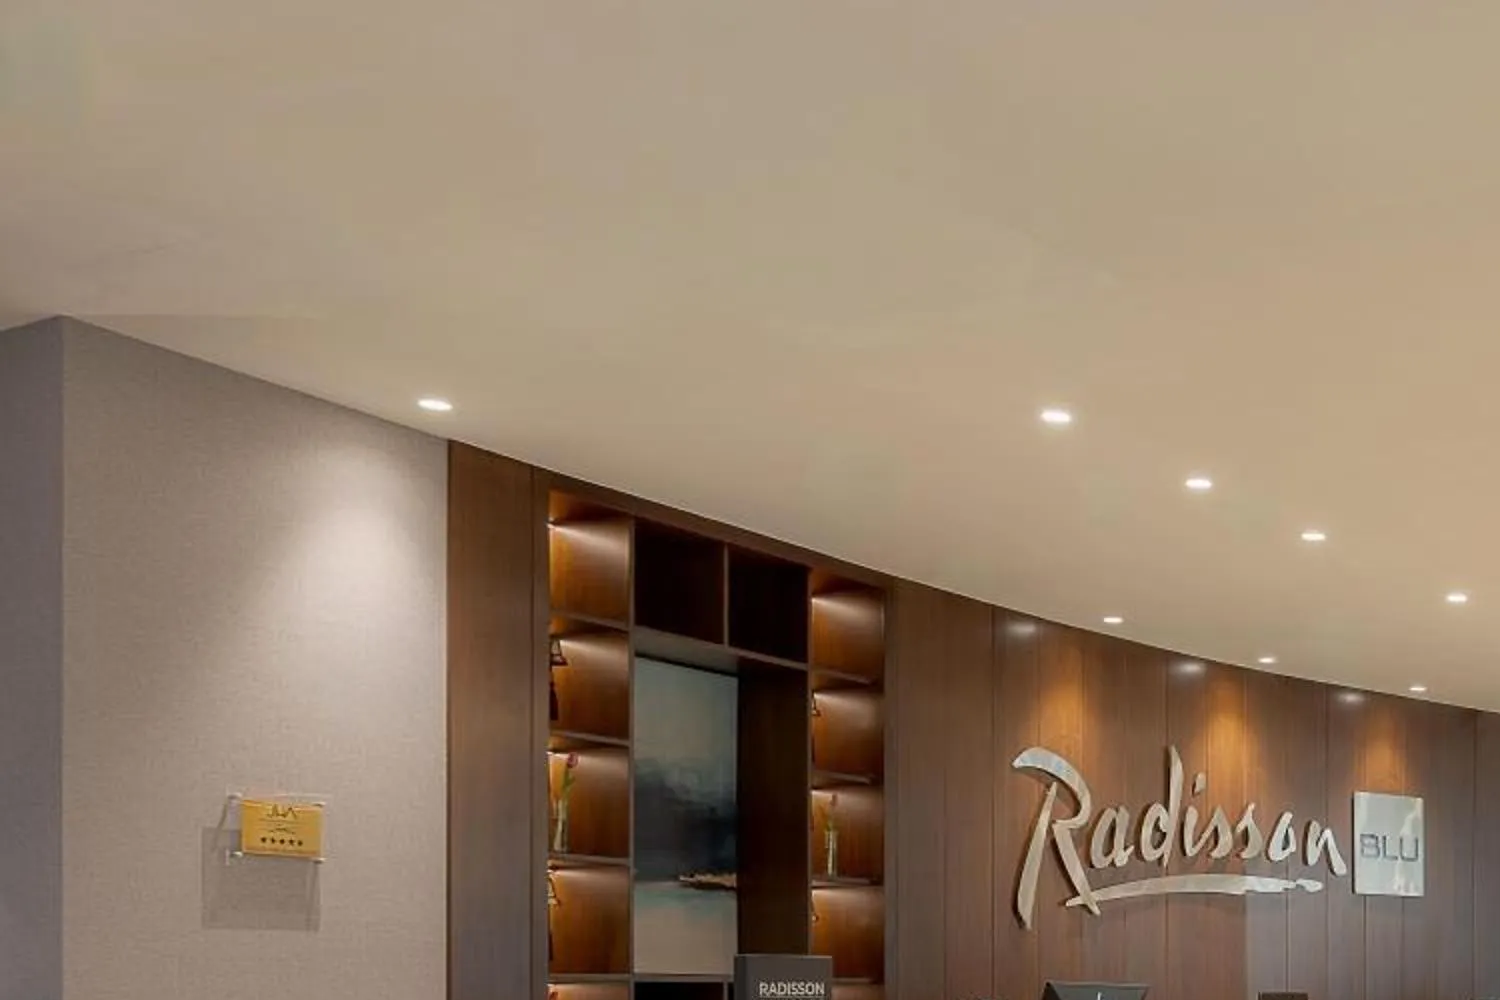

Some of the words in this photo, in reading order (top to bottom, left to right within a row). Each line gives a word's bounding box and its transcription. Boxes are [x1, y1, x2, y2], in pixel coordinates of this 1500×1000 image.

[1011, 745, 1348, 930] Radisson
[1359, 832, 1421, 864] BLU
[759, 982, 825, 996] RADISSON
